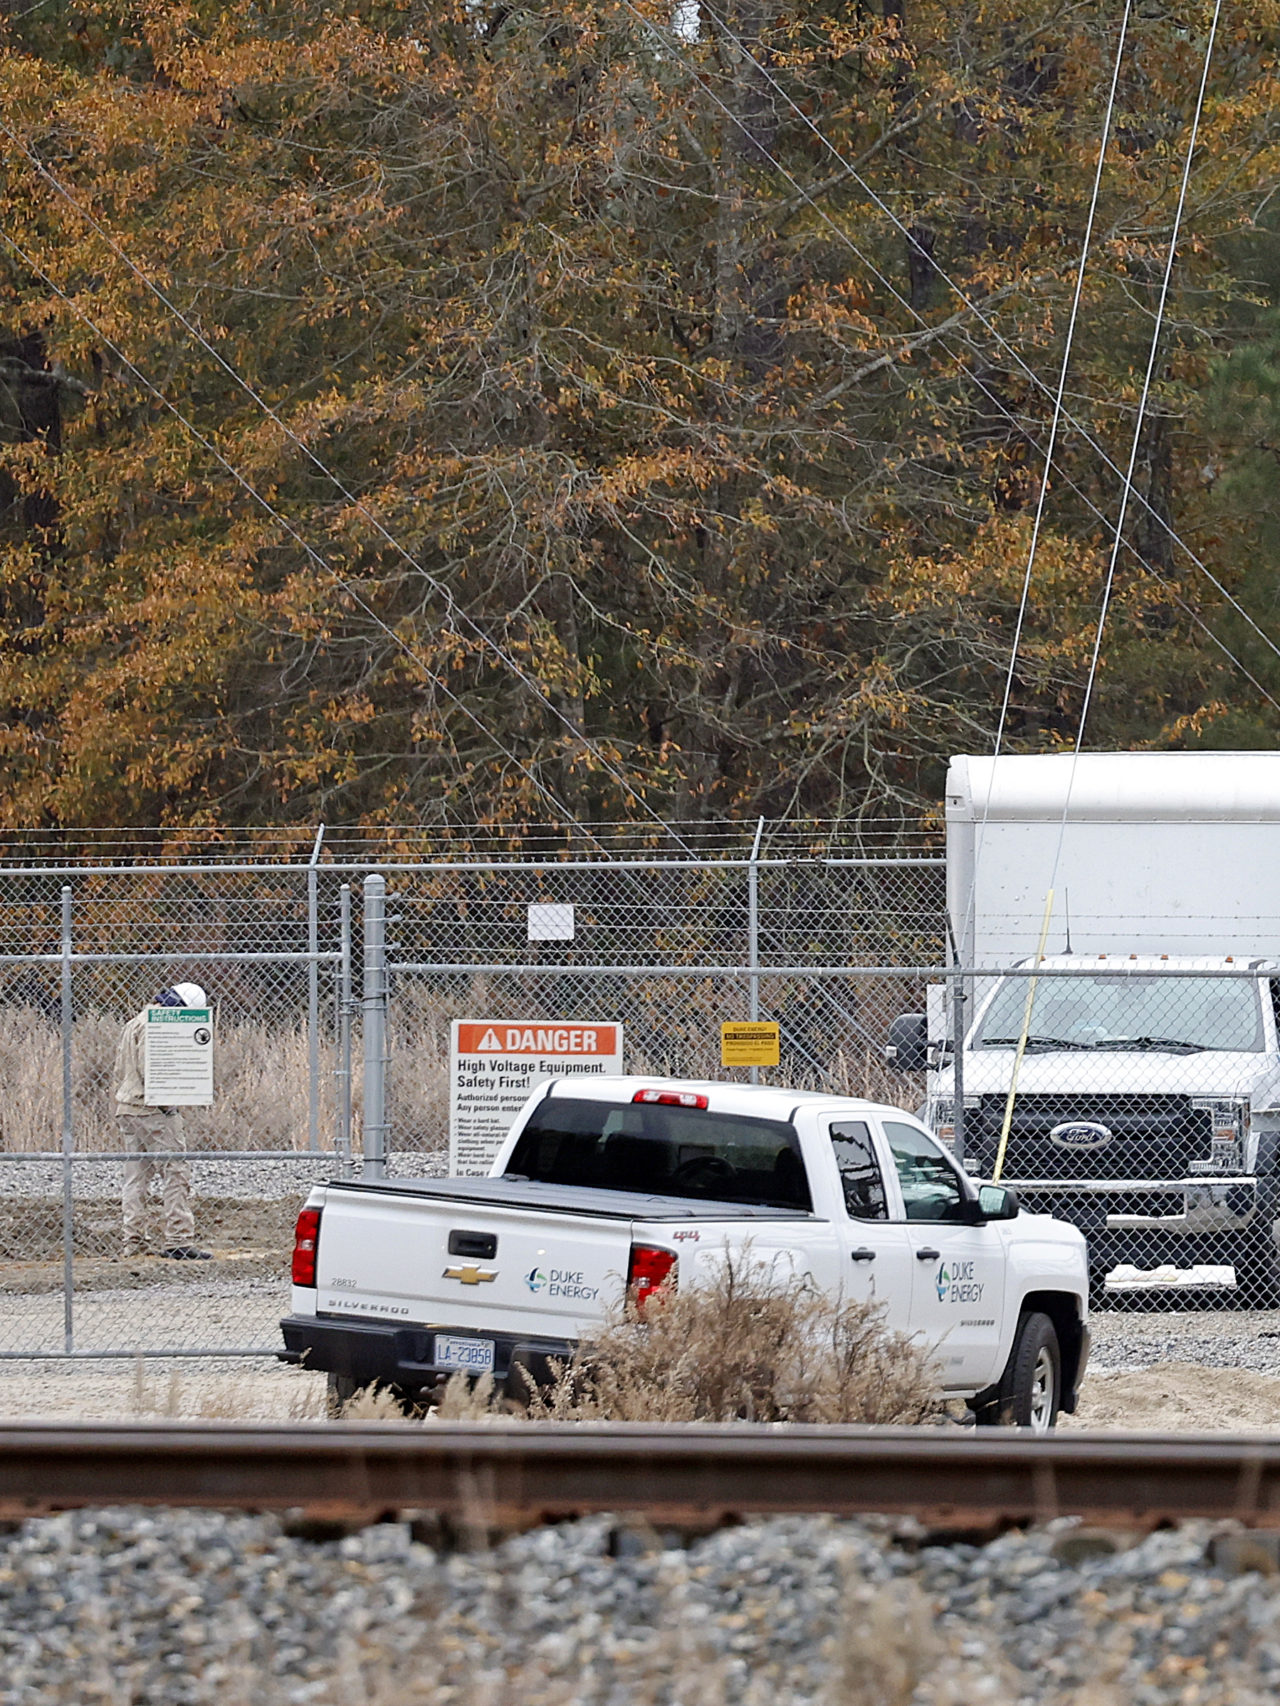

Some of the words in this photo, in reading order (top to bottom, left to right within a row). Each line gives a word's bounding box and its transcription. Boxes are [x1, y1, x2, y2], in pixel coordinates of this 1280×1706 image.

[506, 1029, 597, 1052] DANGER
[457, 1060, 486, 1074] High
[489, 1060, 536, 1075] Voltage
[539, 1061, 606, 1076] Equipment.
[457, 1076, 496, 1090] Safety
[499, 1077, 531, 1089] First!
[457, 1093, 499, 1102] Authorized
[457, 1103, 471, 1113] Any
[473, 1105, 500, 1113] person
[1066, 1128, 1096, 1143] Ford
[550, 1269, 584, 1284] DUKE
[952, 1262, 975, 1280] DUKE
[550, 1284, 600, 1300] ENERGY
[950, 1284, 985, 1302] ENERGY
